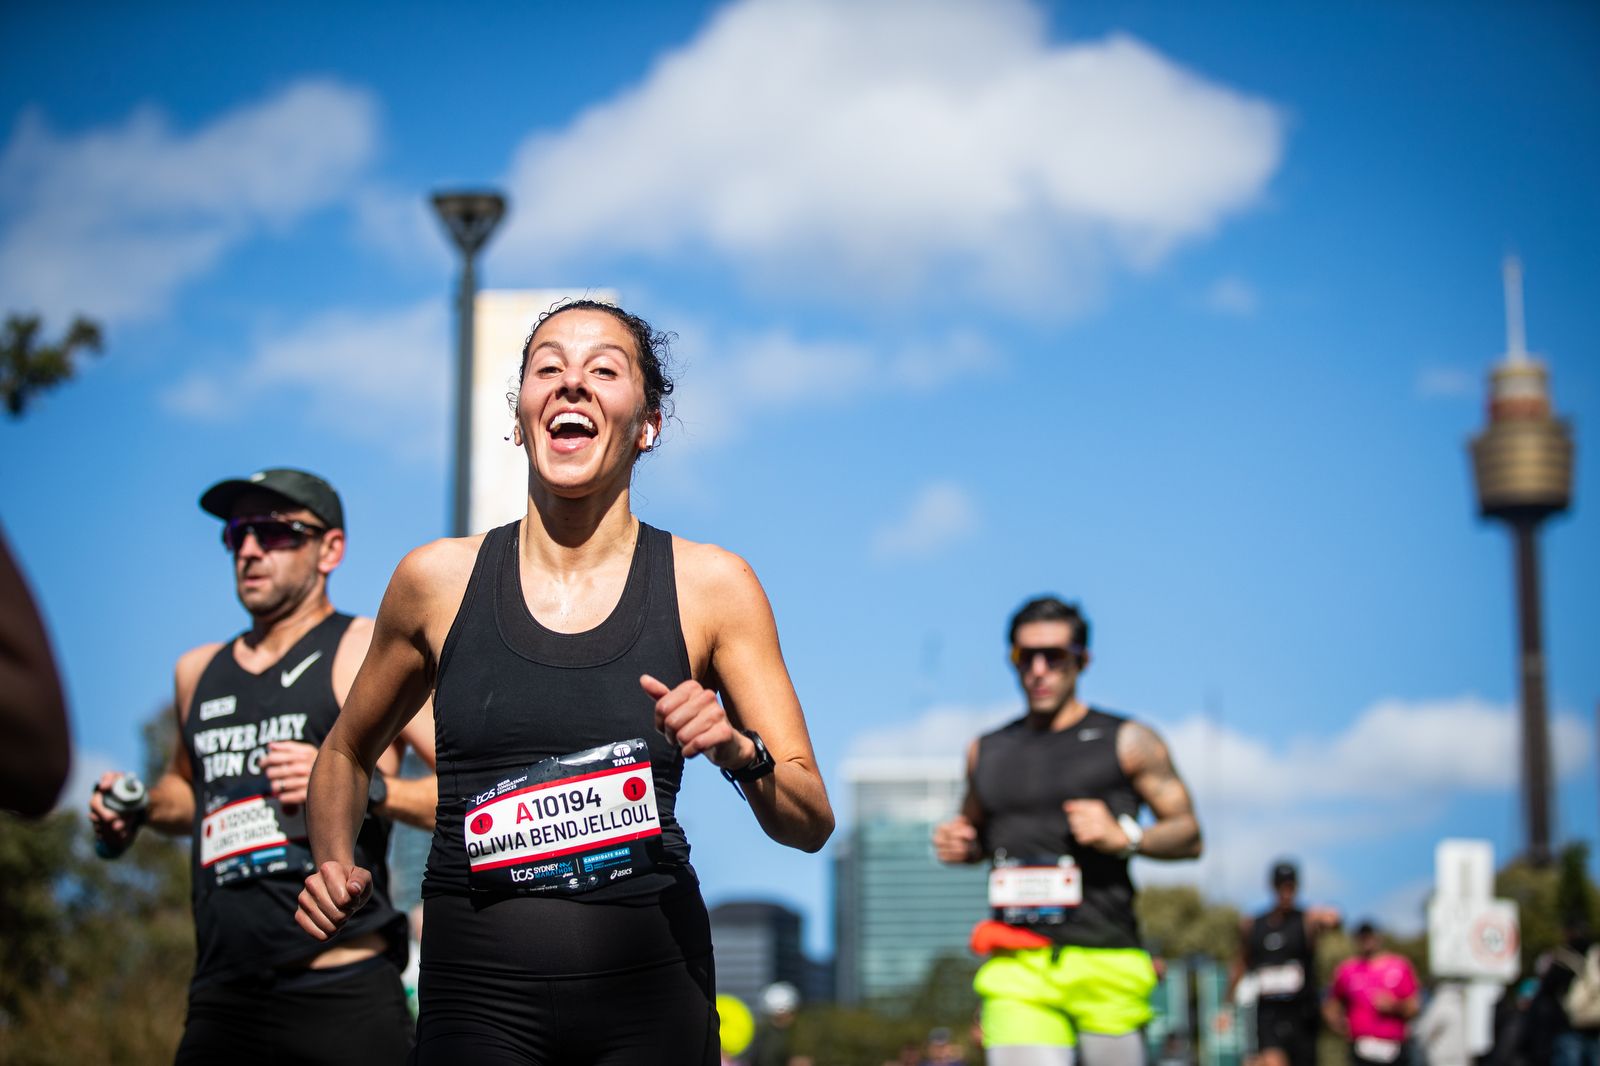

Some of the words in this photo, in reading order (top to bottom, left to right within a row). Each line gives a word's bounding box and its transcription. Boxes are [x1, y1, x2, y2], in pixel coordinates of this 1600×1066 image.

[194, 723, 258, 757] NEVER
[258, 713, 307, 746] LAZY
[612, 756, 636, 767] TATA
[476, 788, 496, 806] tcs
[516, 787, 602, 824] A10194
[467, 831, 527, 859] OLIVIA
[530, 803, 656, 847] BENDJELLOUL
[584, 852, 613, 863] CANDIDATE
[510, 868, 534, 882] tcs
[533, 863, 559, 874] SYDNEY
[534, 866, 573, 879] MARATHON
